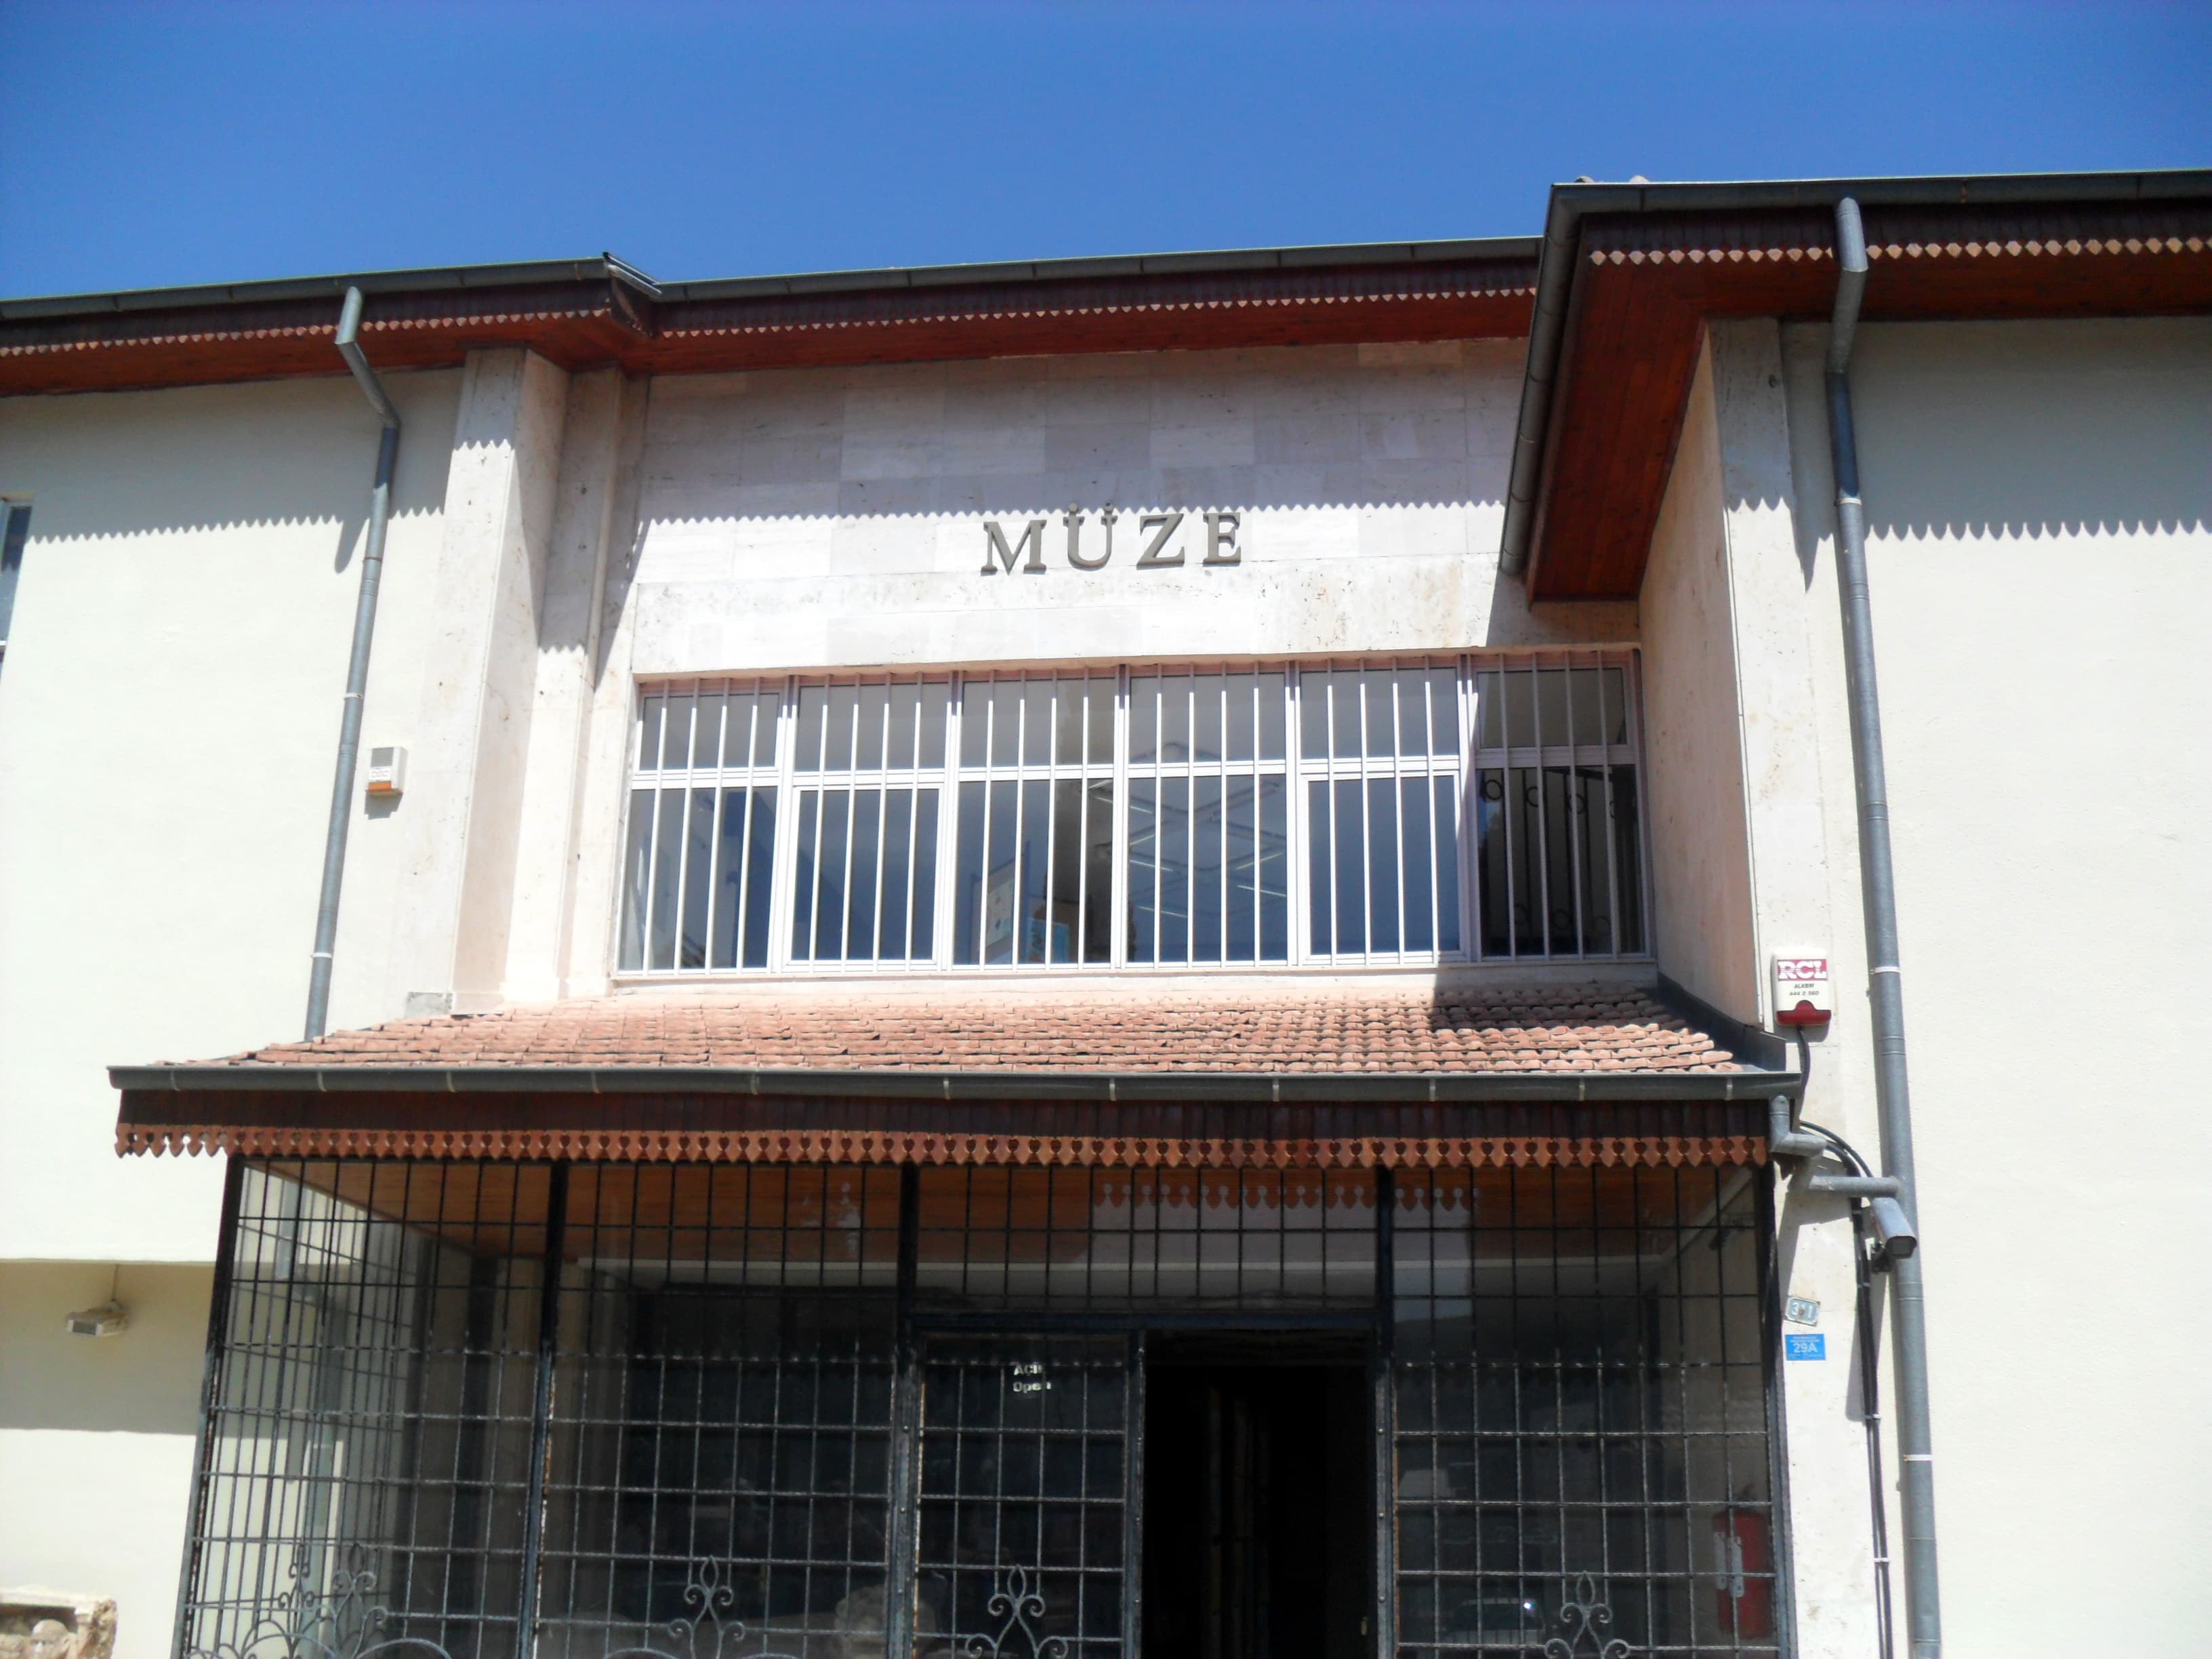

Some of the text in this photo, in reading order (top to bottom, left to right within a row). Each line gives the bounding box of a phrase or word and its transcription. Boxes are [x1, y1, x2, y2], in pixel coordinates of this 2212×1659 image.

[981, 502, 1242, 576] MÜZE
[1778, 960, 1827, 979] RCL
[1793, 1343, 1818, 1353] 29A
